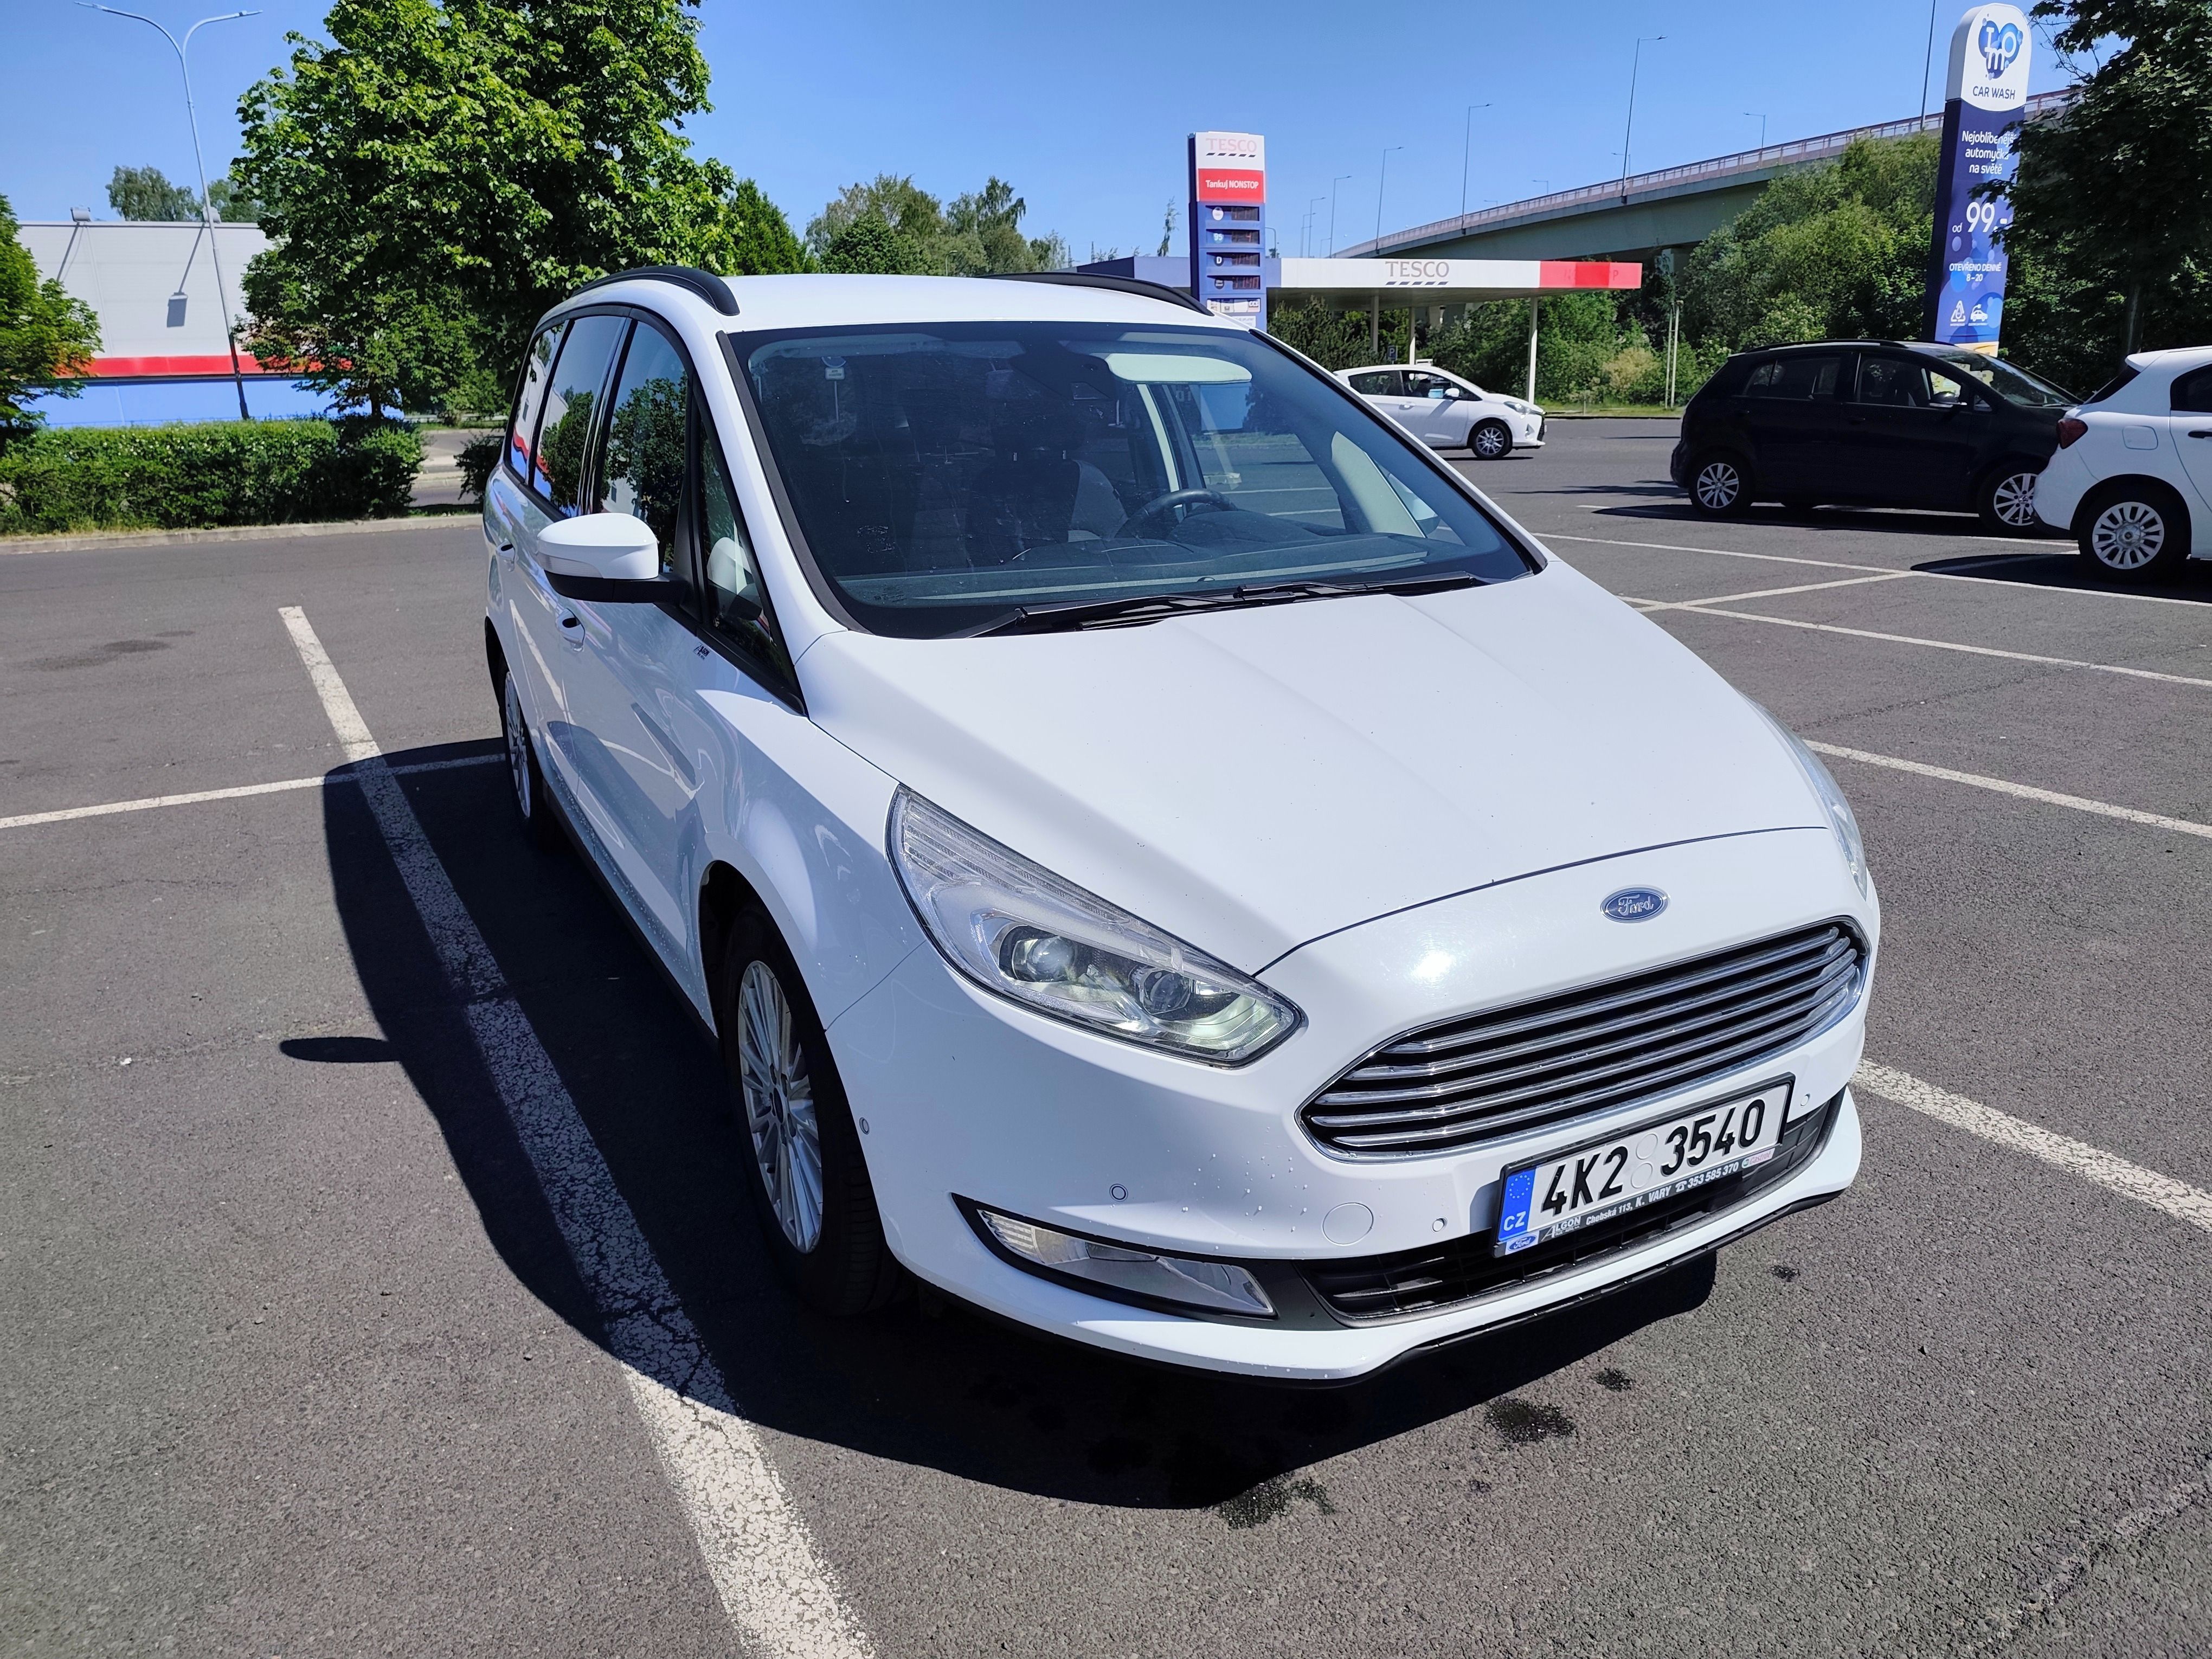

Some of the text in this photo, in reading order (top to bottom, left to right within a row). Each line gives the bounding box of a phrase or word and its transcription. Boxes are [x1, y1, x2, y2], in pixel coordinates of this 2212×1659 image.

[1973, 86, 2016, 100] CAR WASH
[1205, 138, 1257, 152] TESCO
[1965, 147, 2009, 162] automyčka
[1969, 163, 2003, 175] na světě
[1205, 179, 1259, 190] Tankuj NONSTOP
[1952, 222, 1963, 233] od
[1213, 233, 1224, 241] 95
[1216, 256, 1223, 264] D
[1949, 261, 2002, 272] OTEVŘENO DENNĚ
[1385, 261, 1449, 278] TESCO
[1389, 348, 1395, 357] P
[1618, 893, 1654, 916] Ford
[1541, 1098, 1766, 1217] 4K2 3540
[1586, 1161, 1739, 1225] Chebská 113, K. VARY 353 585 370
[1503, 1211, 1527, 1231] CZ
[1541, 1216, 1581, 1242] ALGON
[1513, 1238, 1531, 1249] Ford
